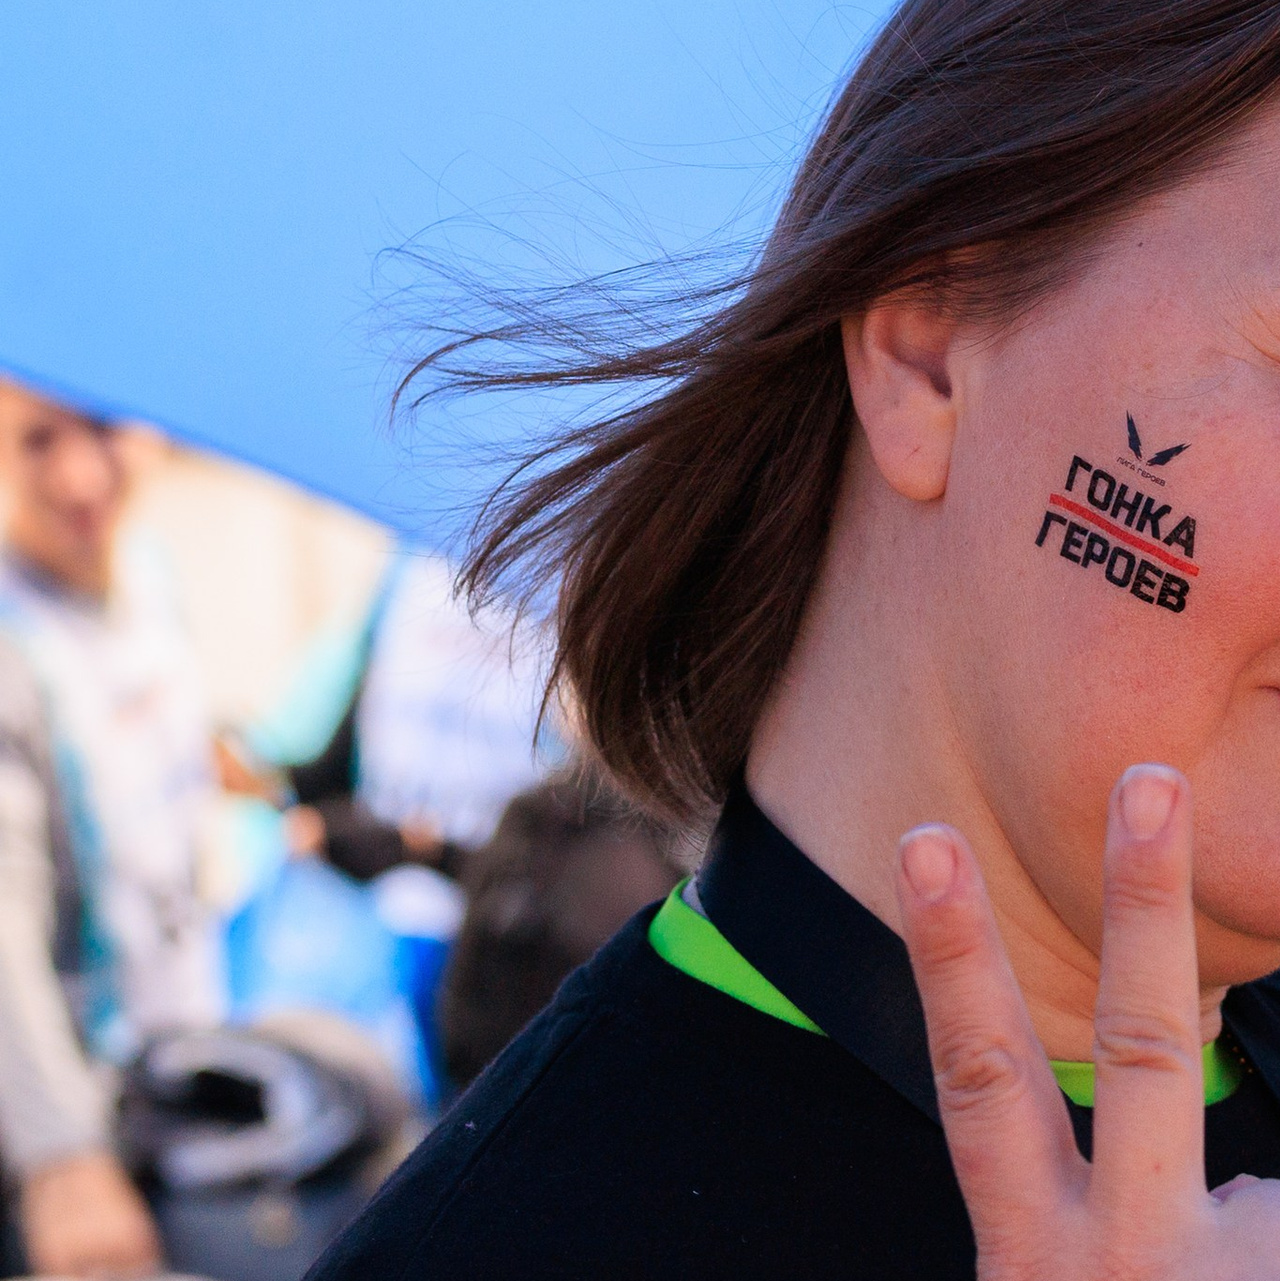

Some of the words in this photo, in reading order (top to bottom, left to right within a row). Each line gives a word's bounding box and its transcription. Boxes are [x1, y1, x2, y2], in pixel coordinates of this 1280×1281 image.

[1064, 454, 1197, 558] ГОНКА
[1136, 467, 1166, 487] ГЕРОЕВ
[1034, 510, 1191, 613] ГЕРОЕВ
